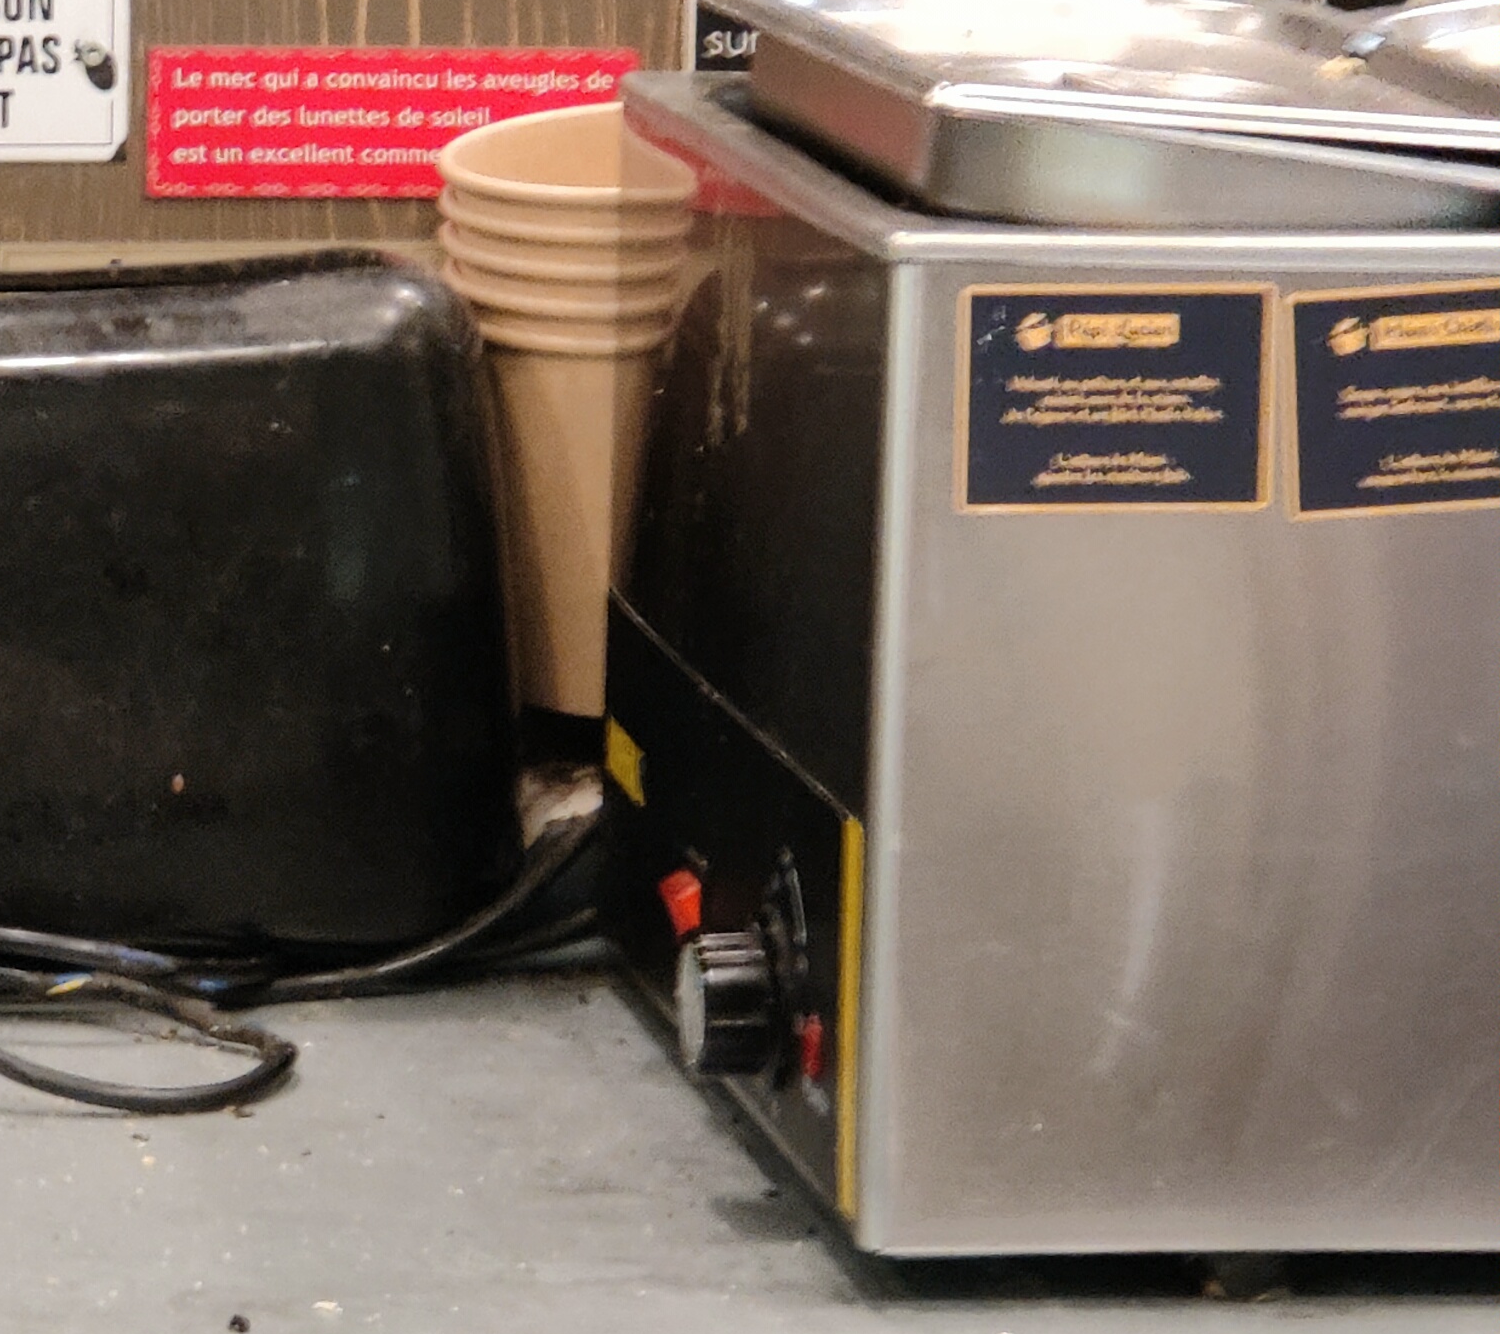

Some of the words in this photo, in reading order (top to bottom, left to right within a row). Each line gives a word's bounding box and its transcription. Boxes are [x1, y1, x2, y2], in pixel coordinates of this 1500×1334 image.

[173, 68, 204, 89] Le
[210, 71, 257, 89] mec
[264, 68, 300, 94] qui
[305, 72, 319, 89] a
[326, 68, 440, 89] convaincu
[445, 67, 478, 90] les
[483, 69, 581, 97] aveugles
[586, 68, 615, 90] de
[172, 108, 247, 131] porter
[253, 105, 292, 127] des
[299, 105, 392, 128] lunettes
[398, 104, 426, 127] de
[432, 105, 491, 128] soleil
[171, 145, 207, 166] est
[214, 147, 244, 166] un
[249, 143, 354, 166] excellent
